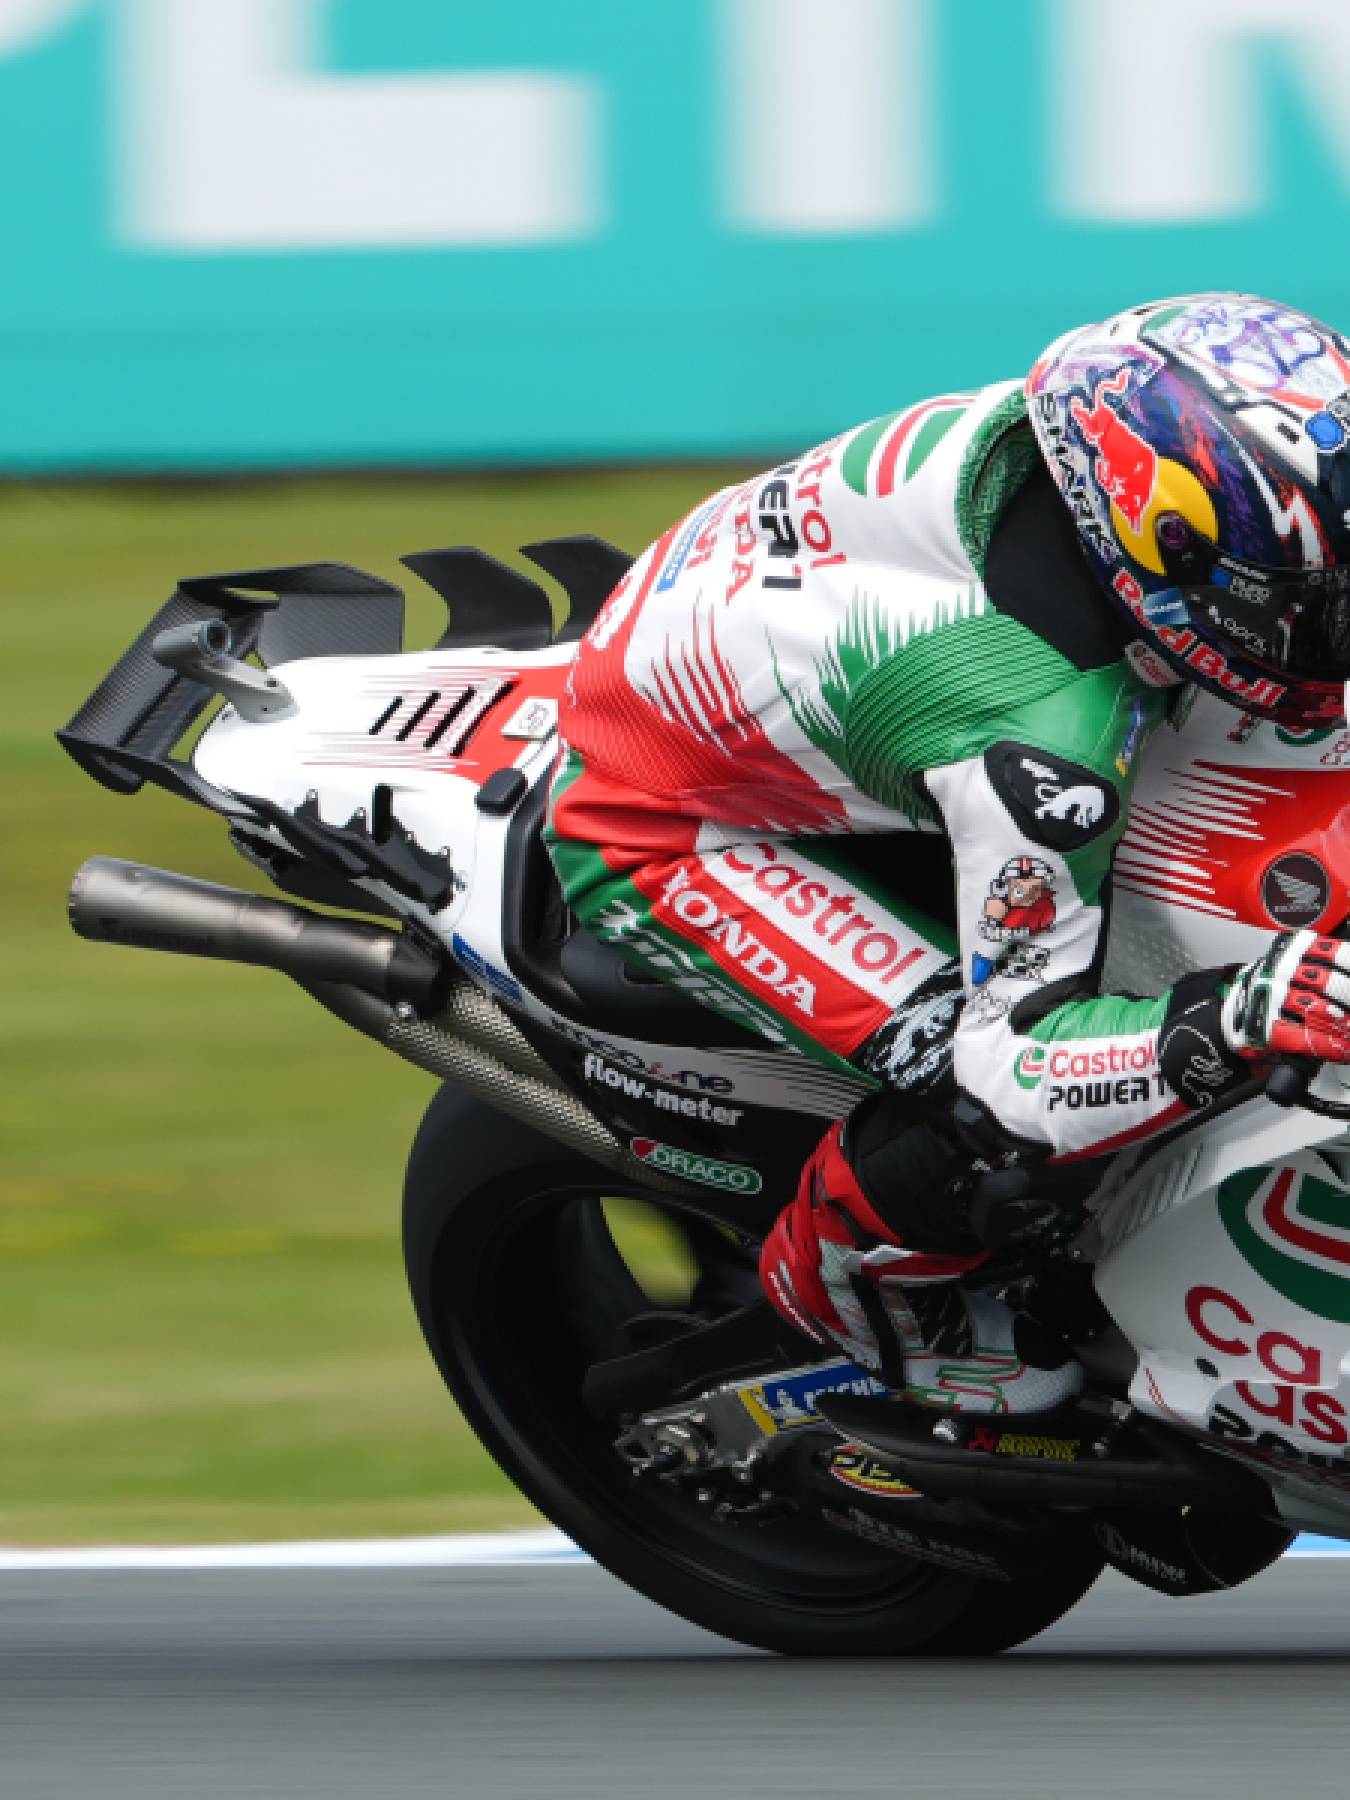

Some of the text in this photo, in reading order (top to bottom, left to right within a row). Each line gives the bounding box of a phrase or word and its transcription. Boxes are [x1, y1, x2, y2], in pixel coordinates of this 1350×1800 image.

[1185, 642, 1289, 707] Bull
[723, 843, 926, 984] Castrol
[584, 1055, 745, 1126] flow-meter
[1049, 1039, 1157, 1079] Castrol
